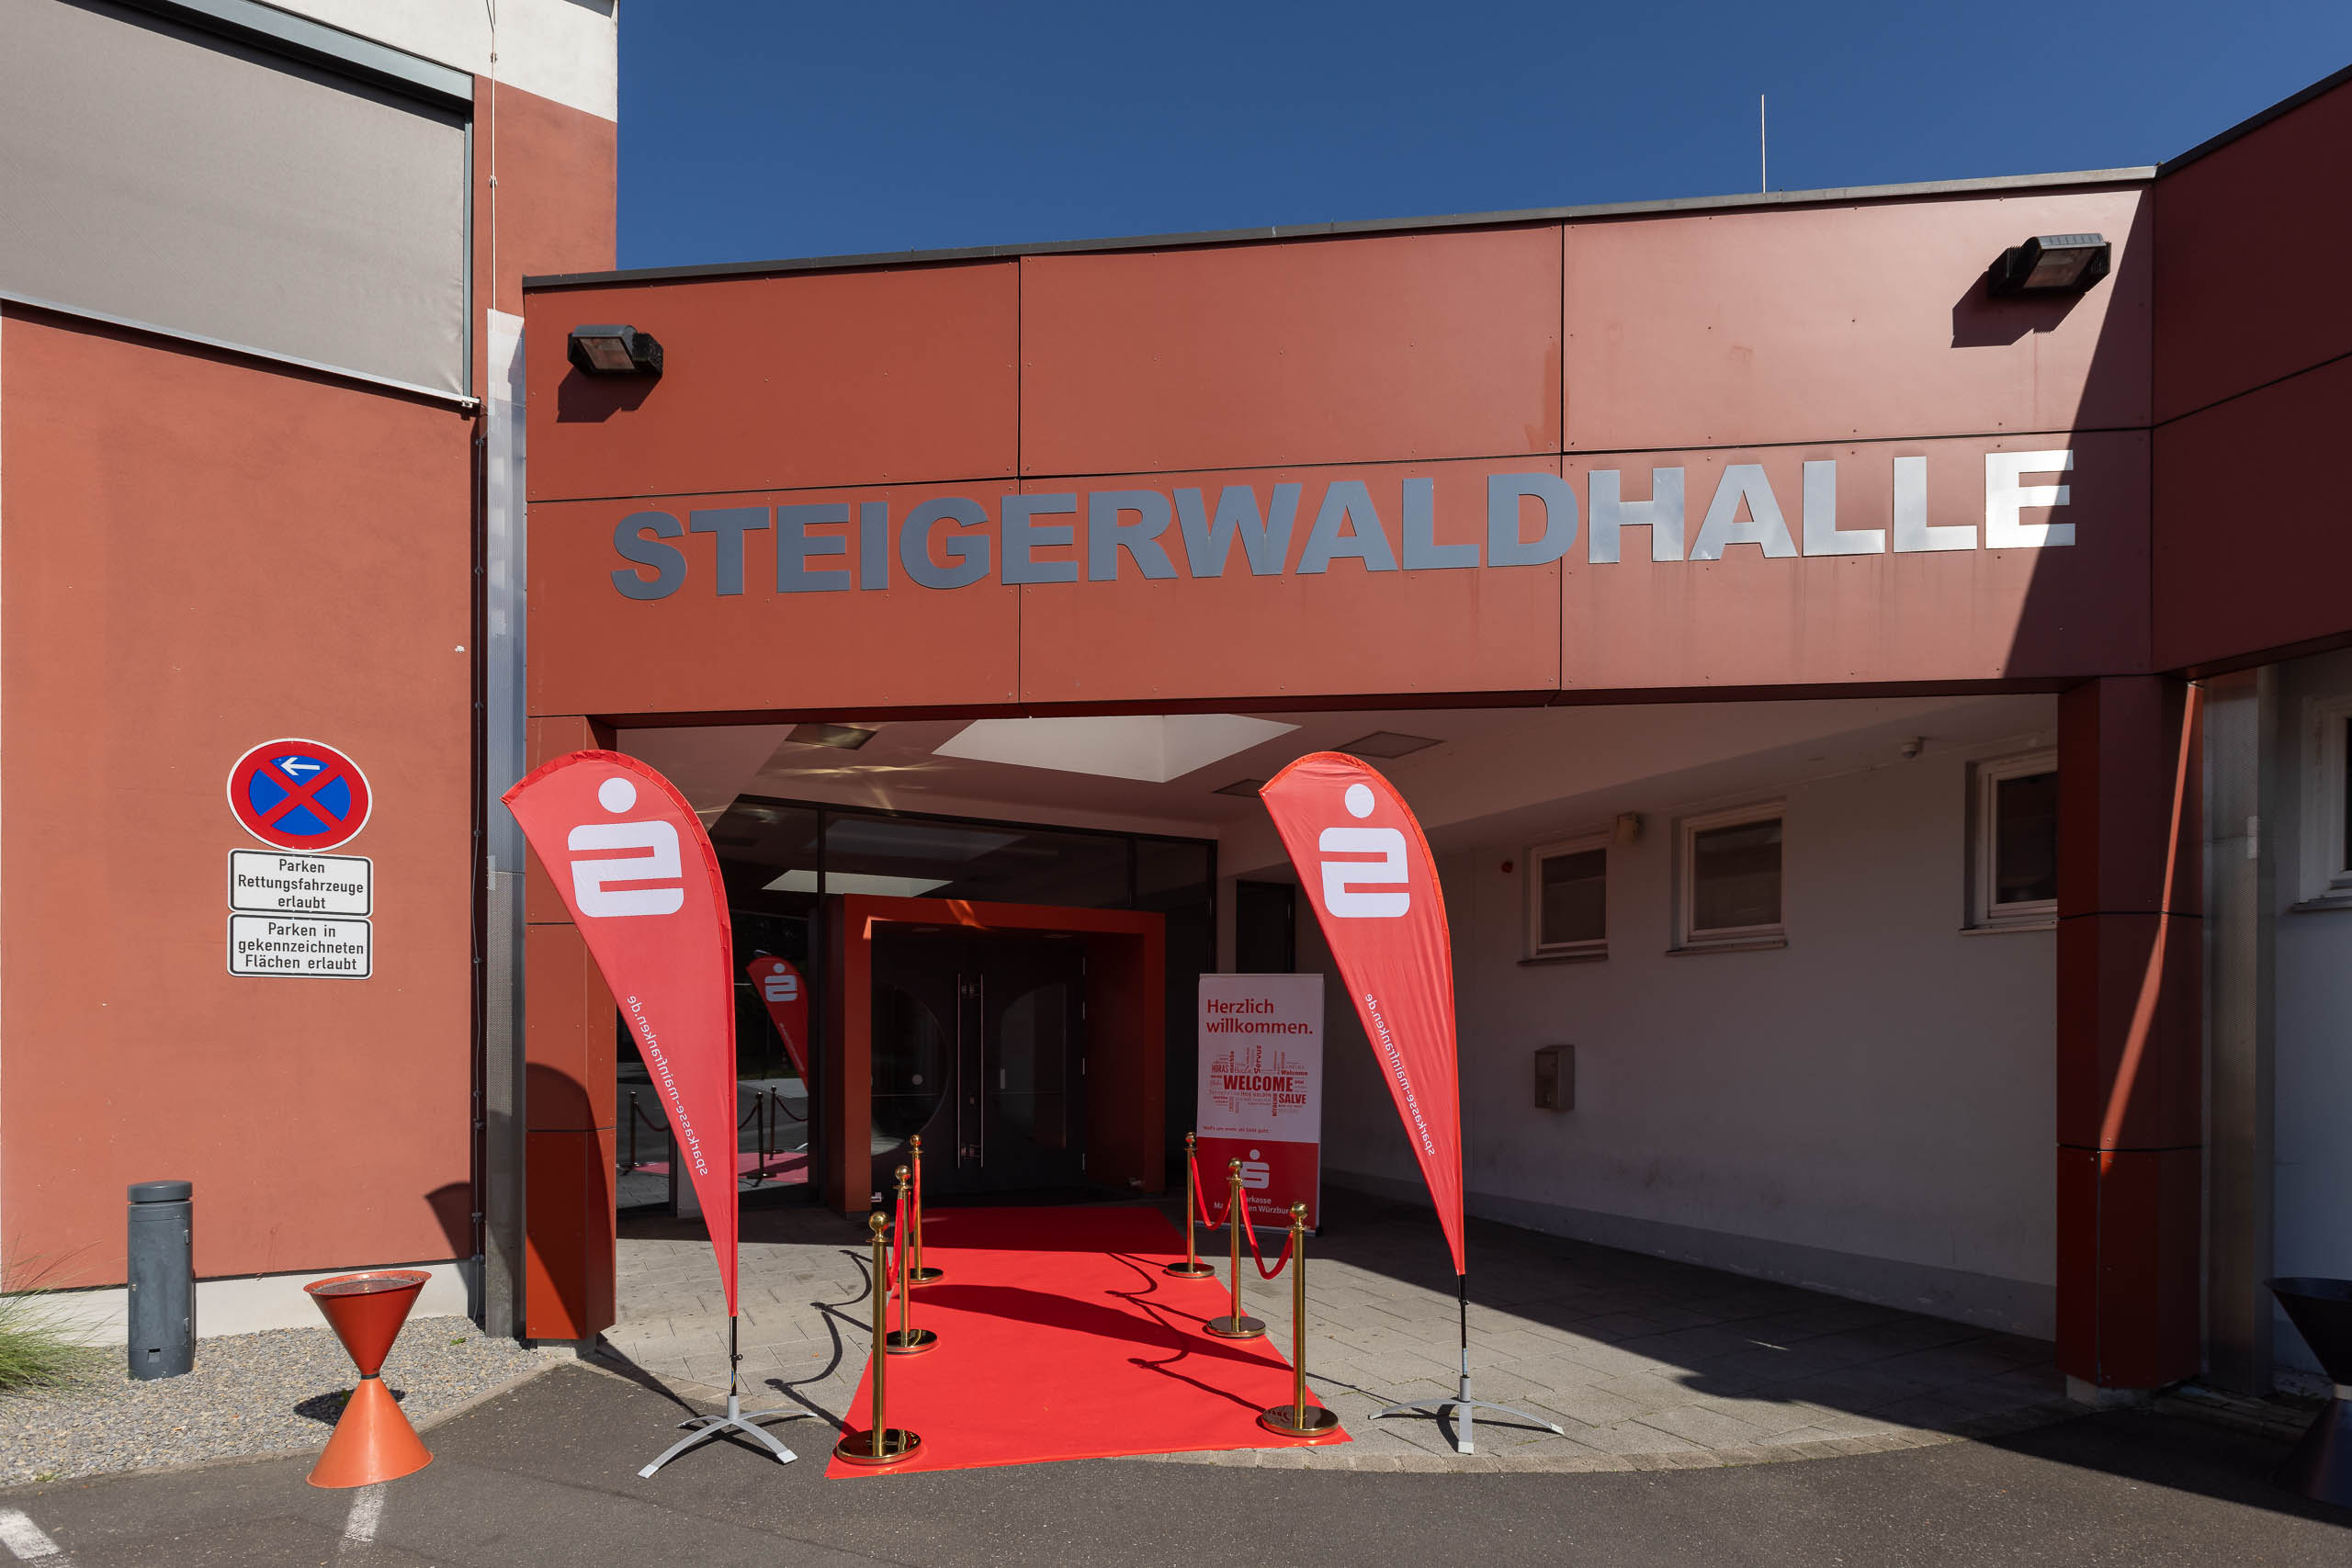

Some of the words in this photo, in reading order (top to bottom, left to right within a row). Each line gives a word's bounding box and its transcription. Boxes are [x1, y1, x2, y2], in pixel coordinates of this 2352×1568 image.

[611, 449, 2075, 601] STEIGERWALDHALLE
[278, 858, 325, 874] Parken
[238, 874, 364, 897] Rettungsfahrzeuge
[277, 895, 326, 909] erlaubt
[268, 921, 317, 937] Parken
[323, 924, 336, 938] in
[238, 938, 364, 954] gekennzeichneten
[245, 953, 300, 969] Flächen
[308, 956, 357, 971] erlaubt
[1207, 998, 1274, 1014] Herzlich
[1205, 1017, 1314, 1035] willkommen.
[1223, 1075, 1294, 1092] WELCOME
[1278, 1093, 1306, 1105] SALVE
[1258, 1204, 1290, 1215] Würzbur
